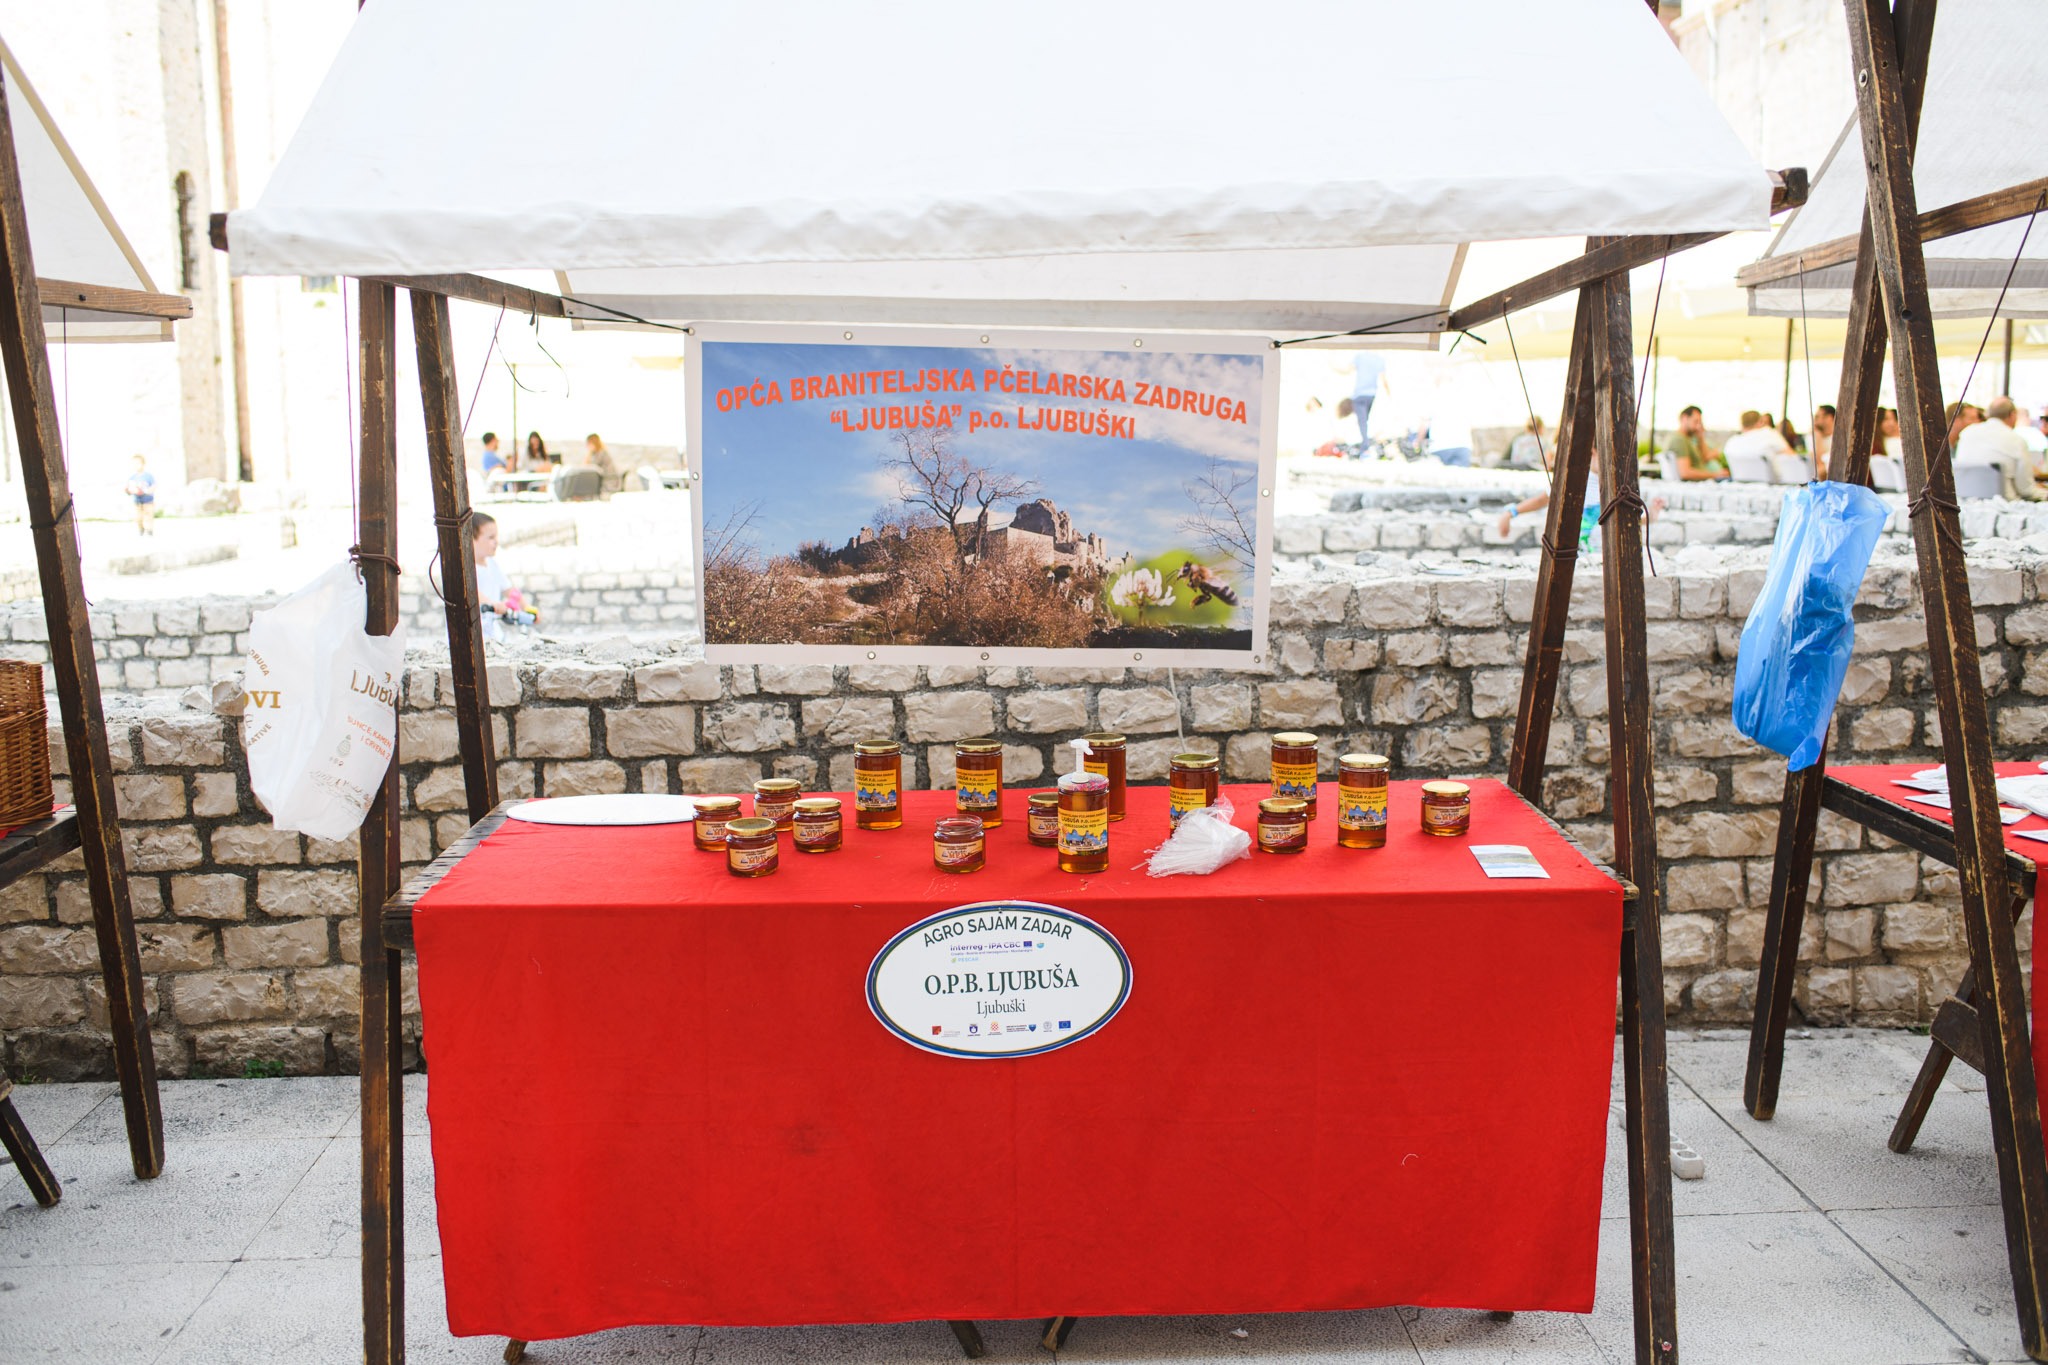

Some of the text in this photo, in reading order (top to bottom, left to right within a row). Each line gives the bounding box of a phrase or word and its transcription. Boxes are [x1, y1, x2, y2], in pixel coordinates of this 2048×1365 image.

[715, 363, 1248, 425] OPĆA BRANITELJSKA PČELARSKA ZADRUGA
[969, 410, 1009, 434] p.o.
[1017, 406, 1136, 440] LJUBUŠKI
[243, 690, 282, 709] VI
[924, 915, 1072, 947] AGRO SAJAM ZADAR
[1003, 941, 1021, 949] CBC
[924, 963, 1080, 996] O.P.B. LJUBUŠA
[976, 998, 1026, 1019] Ljubuški
